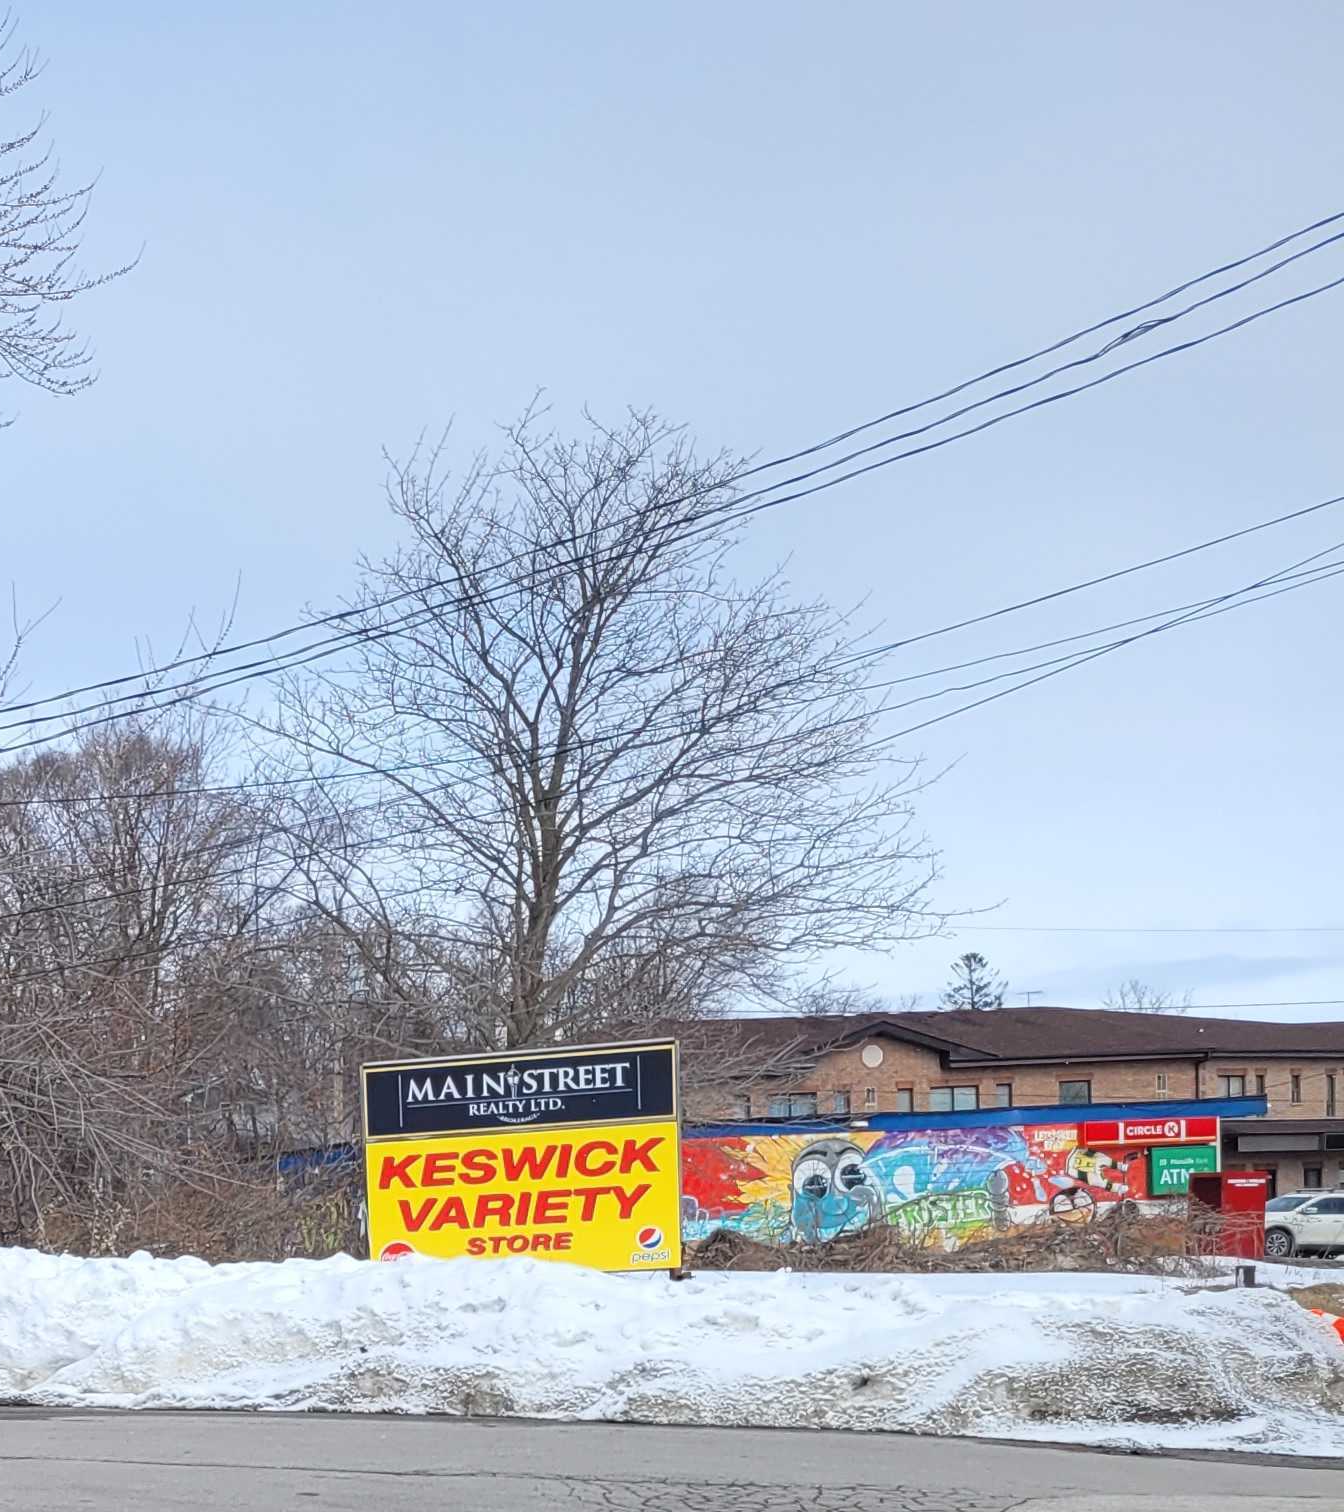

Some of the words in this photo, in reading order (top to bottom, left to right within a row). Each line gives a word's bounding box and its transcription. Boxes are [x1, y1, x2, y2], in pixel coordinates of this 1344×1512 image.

[406, 1071, 506, 1103] MAIN
[522, 1062, 630, 1093] STREET
[469, 1099, 525, 1116] REALTY
[530, 1098, 565, 1112] LTD.
[1126, 1126, 1163, 1136] CIRCLE
[378, 1137, 665, 1190] KESWICK
[397, 1184, 652, 1232] VARIETY
[466, 1232, 573, 1256] STORE
[631, 1250, 670, 1264] pepsi
